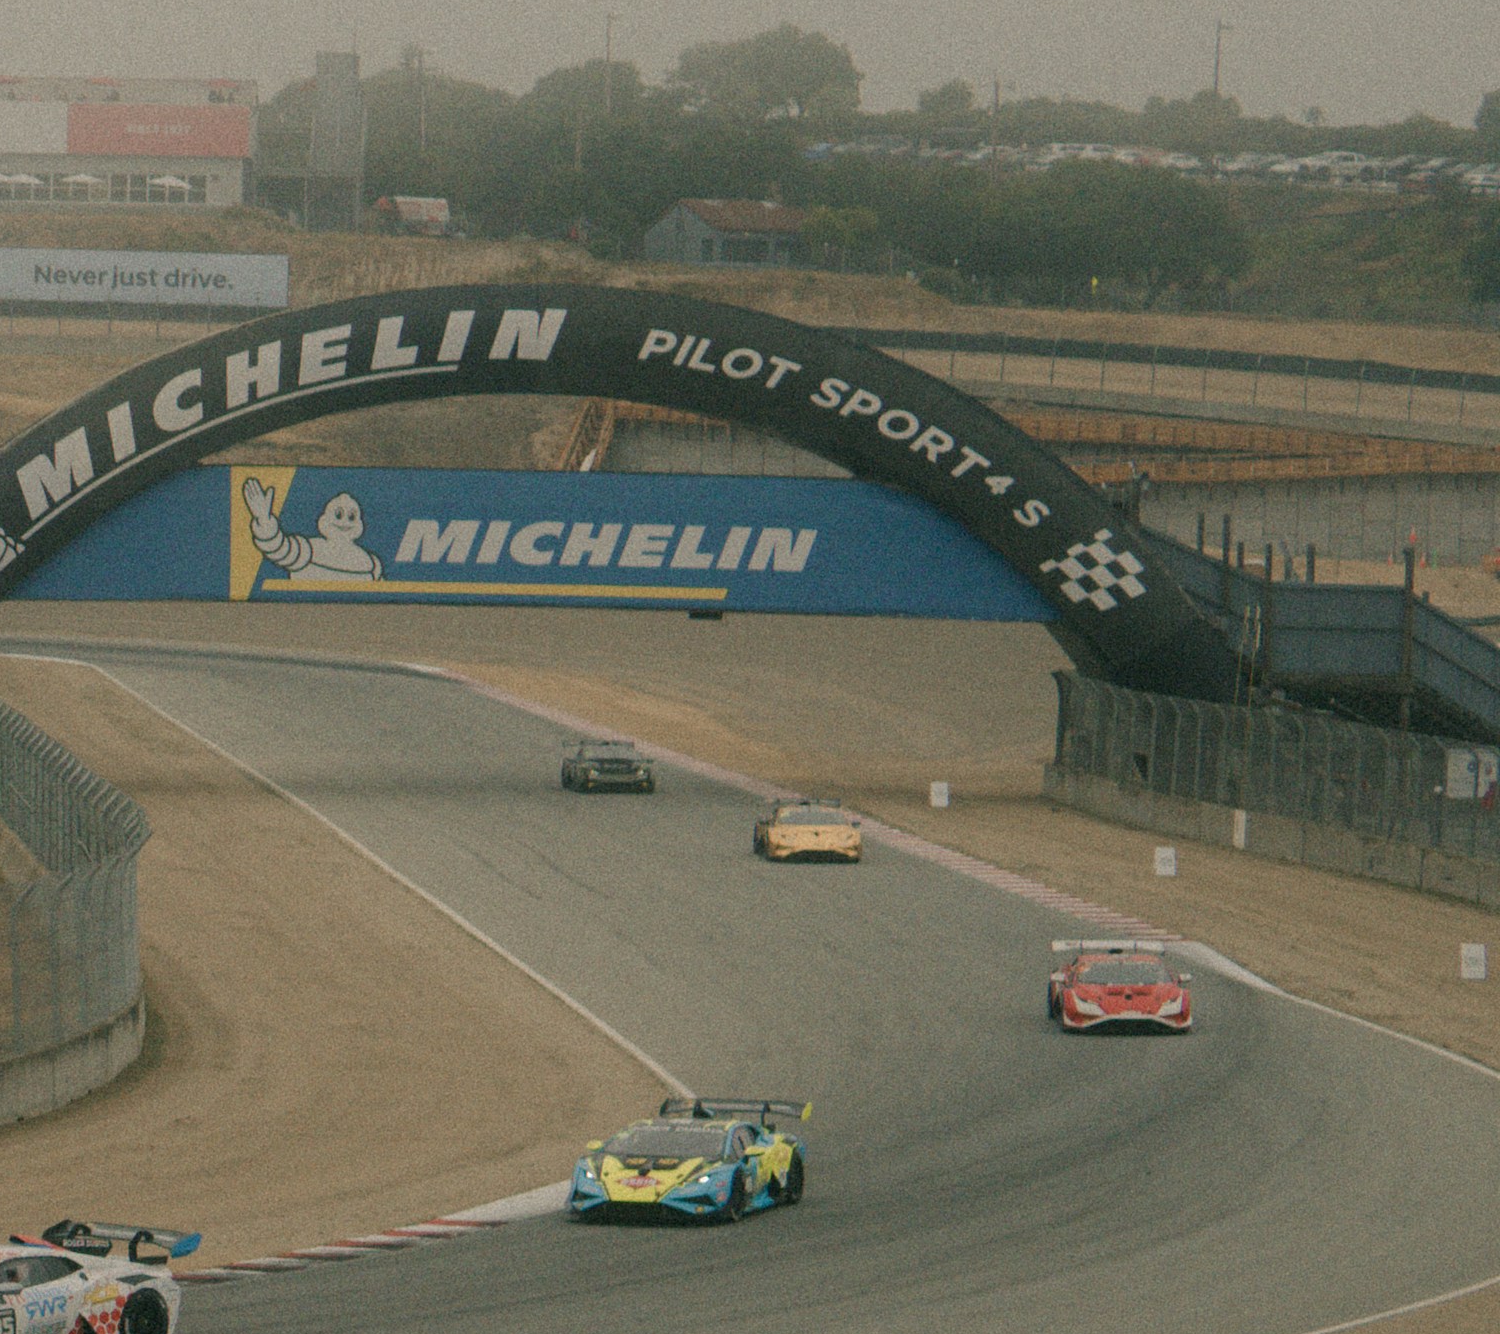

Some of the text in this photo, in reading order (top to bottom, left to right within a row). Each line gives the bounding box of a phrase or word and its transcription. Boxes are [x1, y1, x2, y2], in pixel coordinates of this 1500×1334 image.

[34, 264, 234, 290] Never just drive.
[16, 308, 1052, 528] MICHELIN PILOT SPORT 4 S
[395, 518, 818, 572] MICHELIN
